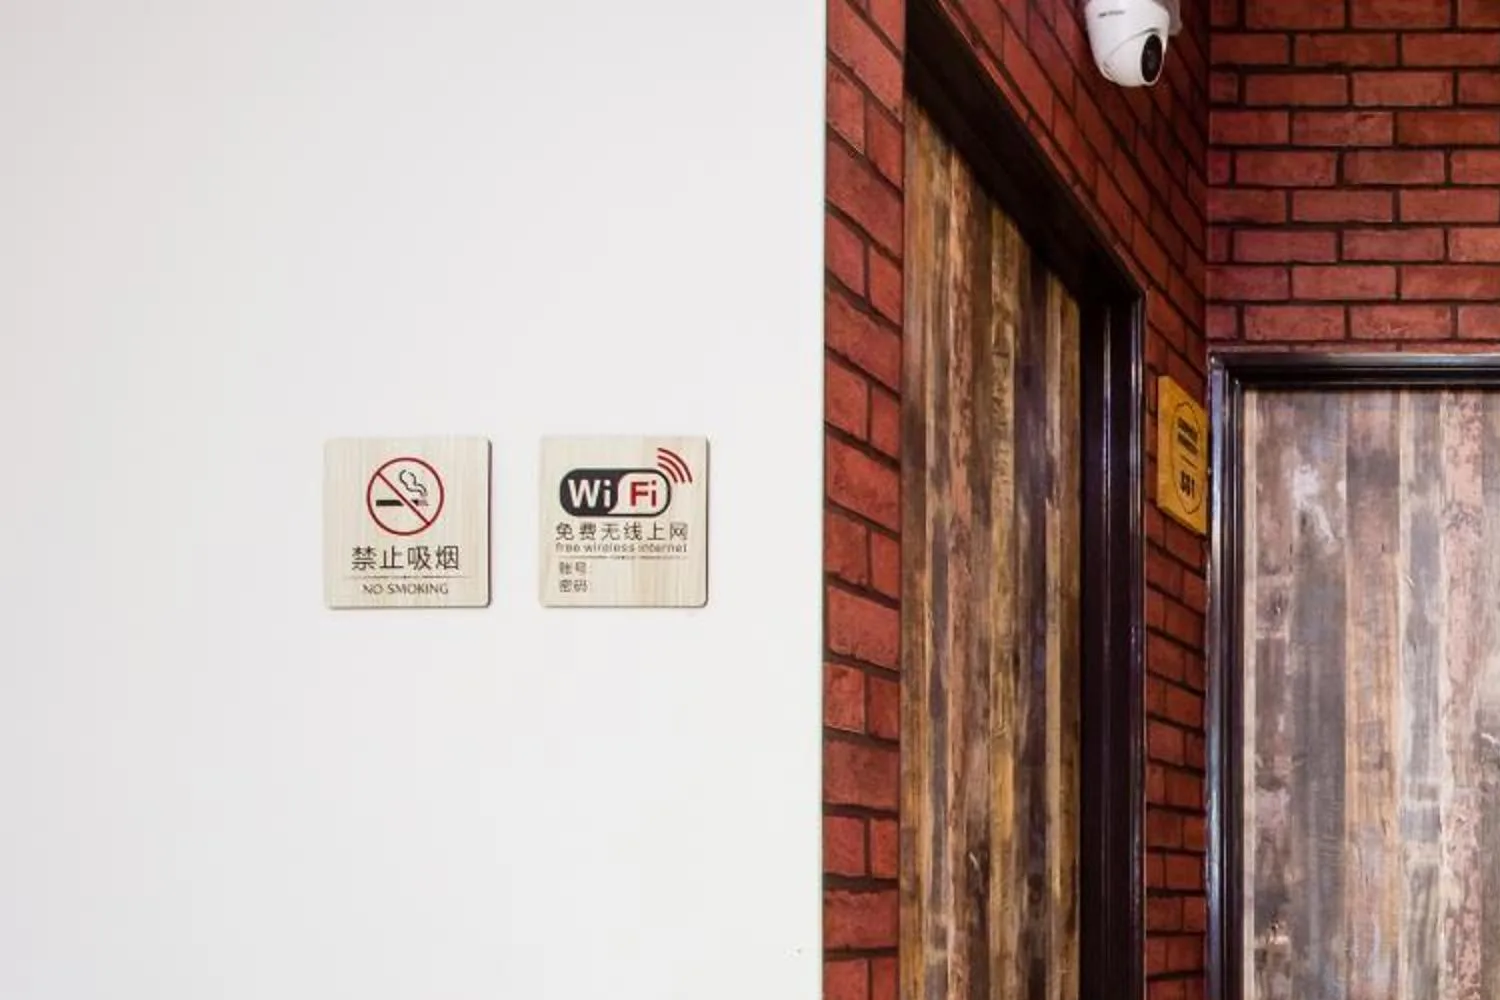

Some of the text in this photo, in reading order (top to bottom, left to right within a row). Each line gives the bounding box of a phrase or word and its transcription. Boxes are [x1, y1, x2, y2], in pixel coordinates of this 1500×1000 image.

[555, 521, 688, 541] 免费无线上网
[555, 542, 687, 553] free wireless internet
[351, 545, 459, 570] 禁止吸烟
[362, 583, 449, 595] NO SMOKING
